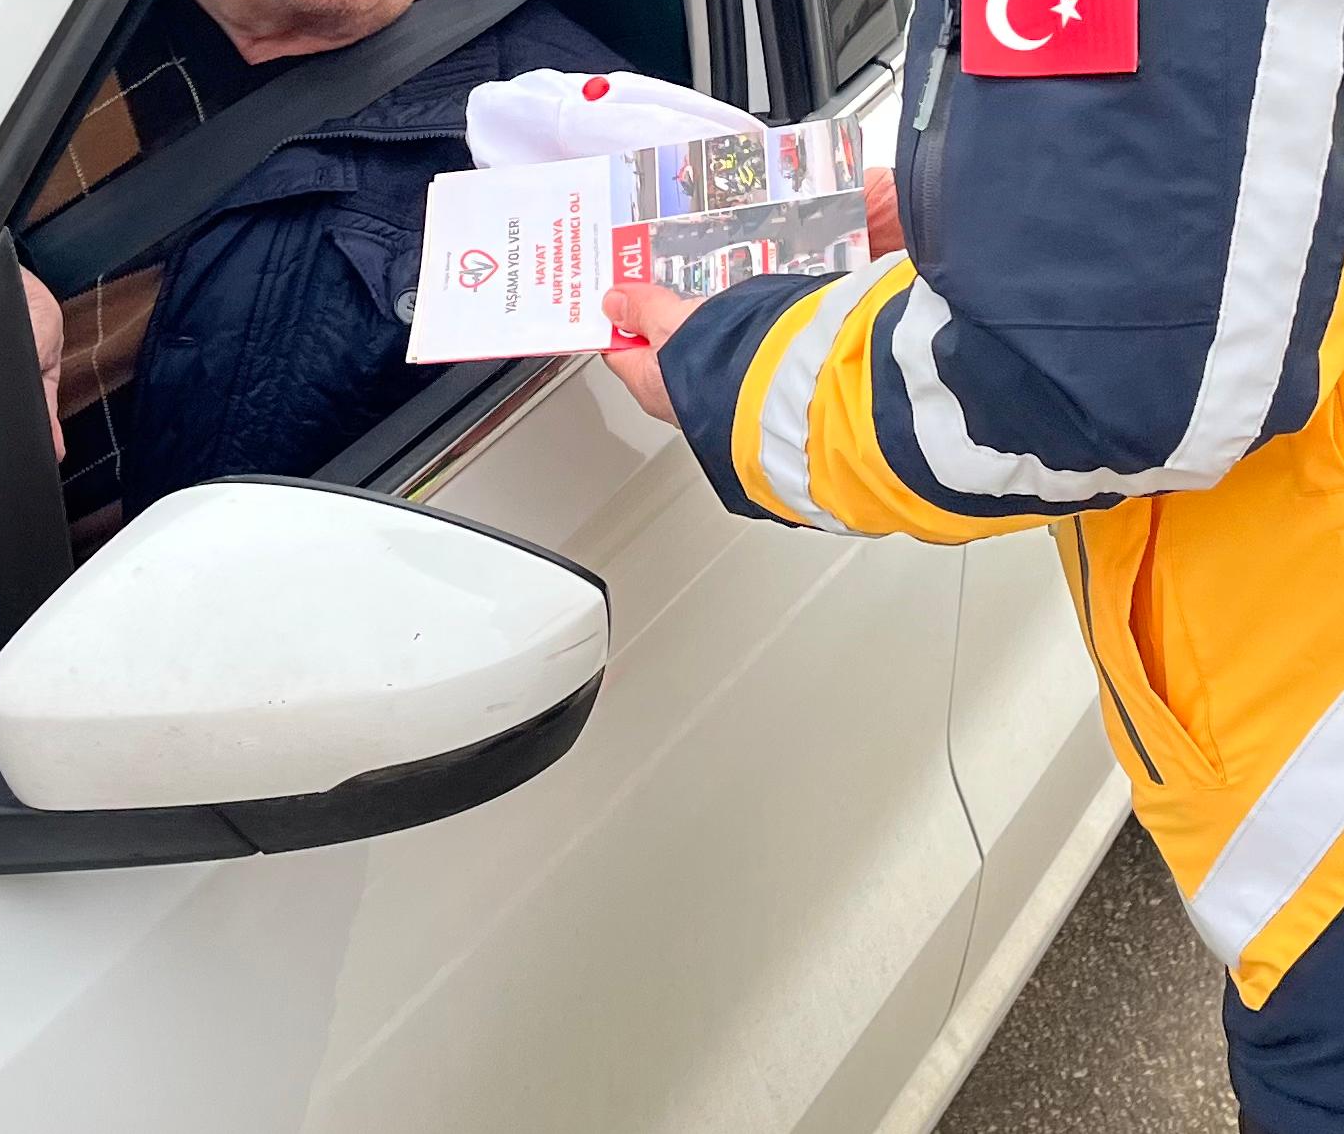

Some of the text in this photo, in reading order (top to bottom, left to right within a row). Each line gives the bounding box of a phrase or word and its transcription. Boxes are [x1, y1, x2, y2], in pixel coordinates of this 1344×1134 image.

[507, 244, 520, 268] YOL
[535, 243, 547, 286] HAYAT
[551, 218, 564, 305] KURTARMAYA
[569, 217, 582, 279] YARDIMCI
[618, 237, 643, 279] ACİL
[504, 269, 521, 314] YAŞAMA
[570, 282, 582, 299] DE
[568, 301, 581, 324] SEN
